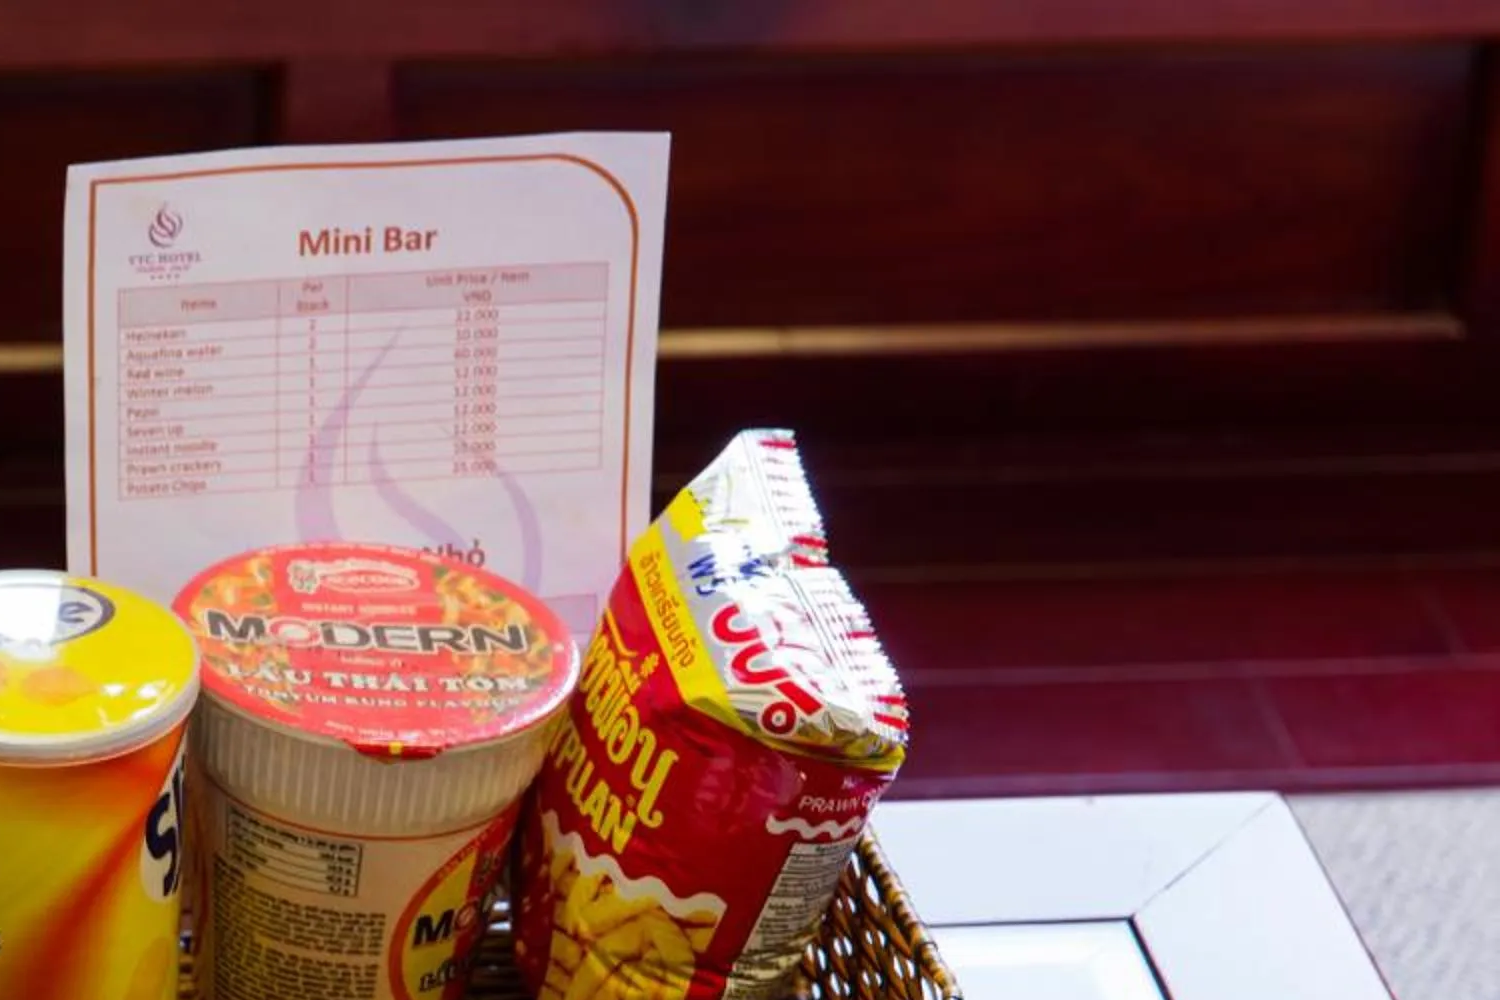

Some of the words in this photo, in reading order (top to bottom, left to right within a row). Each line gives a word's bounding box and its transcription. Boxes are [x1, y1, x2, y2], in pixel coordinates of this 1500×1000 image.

[299, 226, 373, 256] Mini
[384, 226, 438, 253] Bar
[127, 368, 151, 380] Red
[154, 367, 185, 378] wine
[203, 608, 529, 655] MODERN
